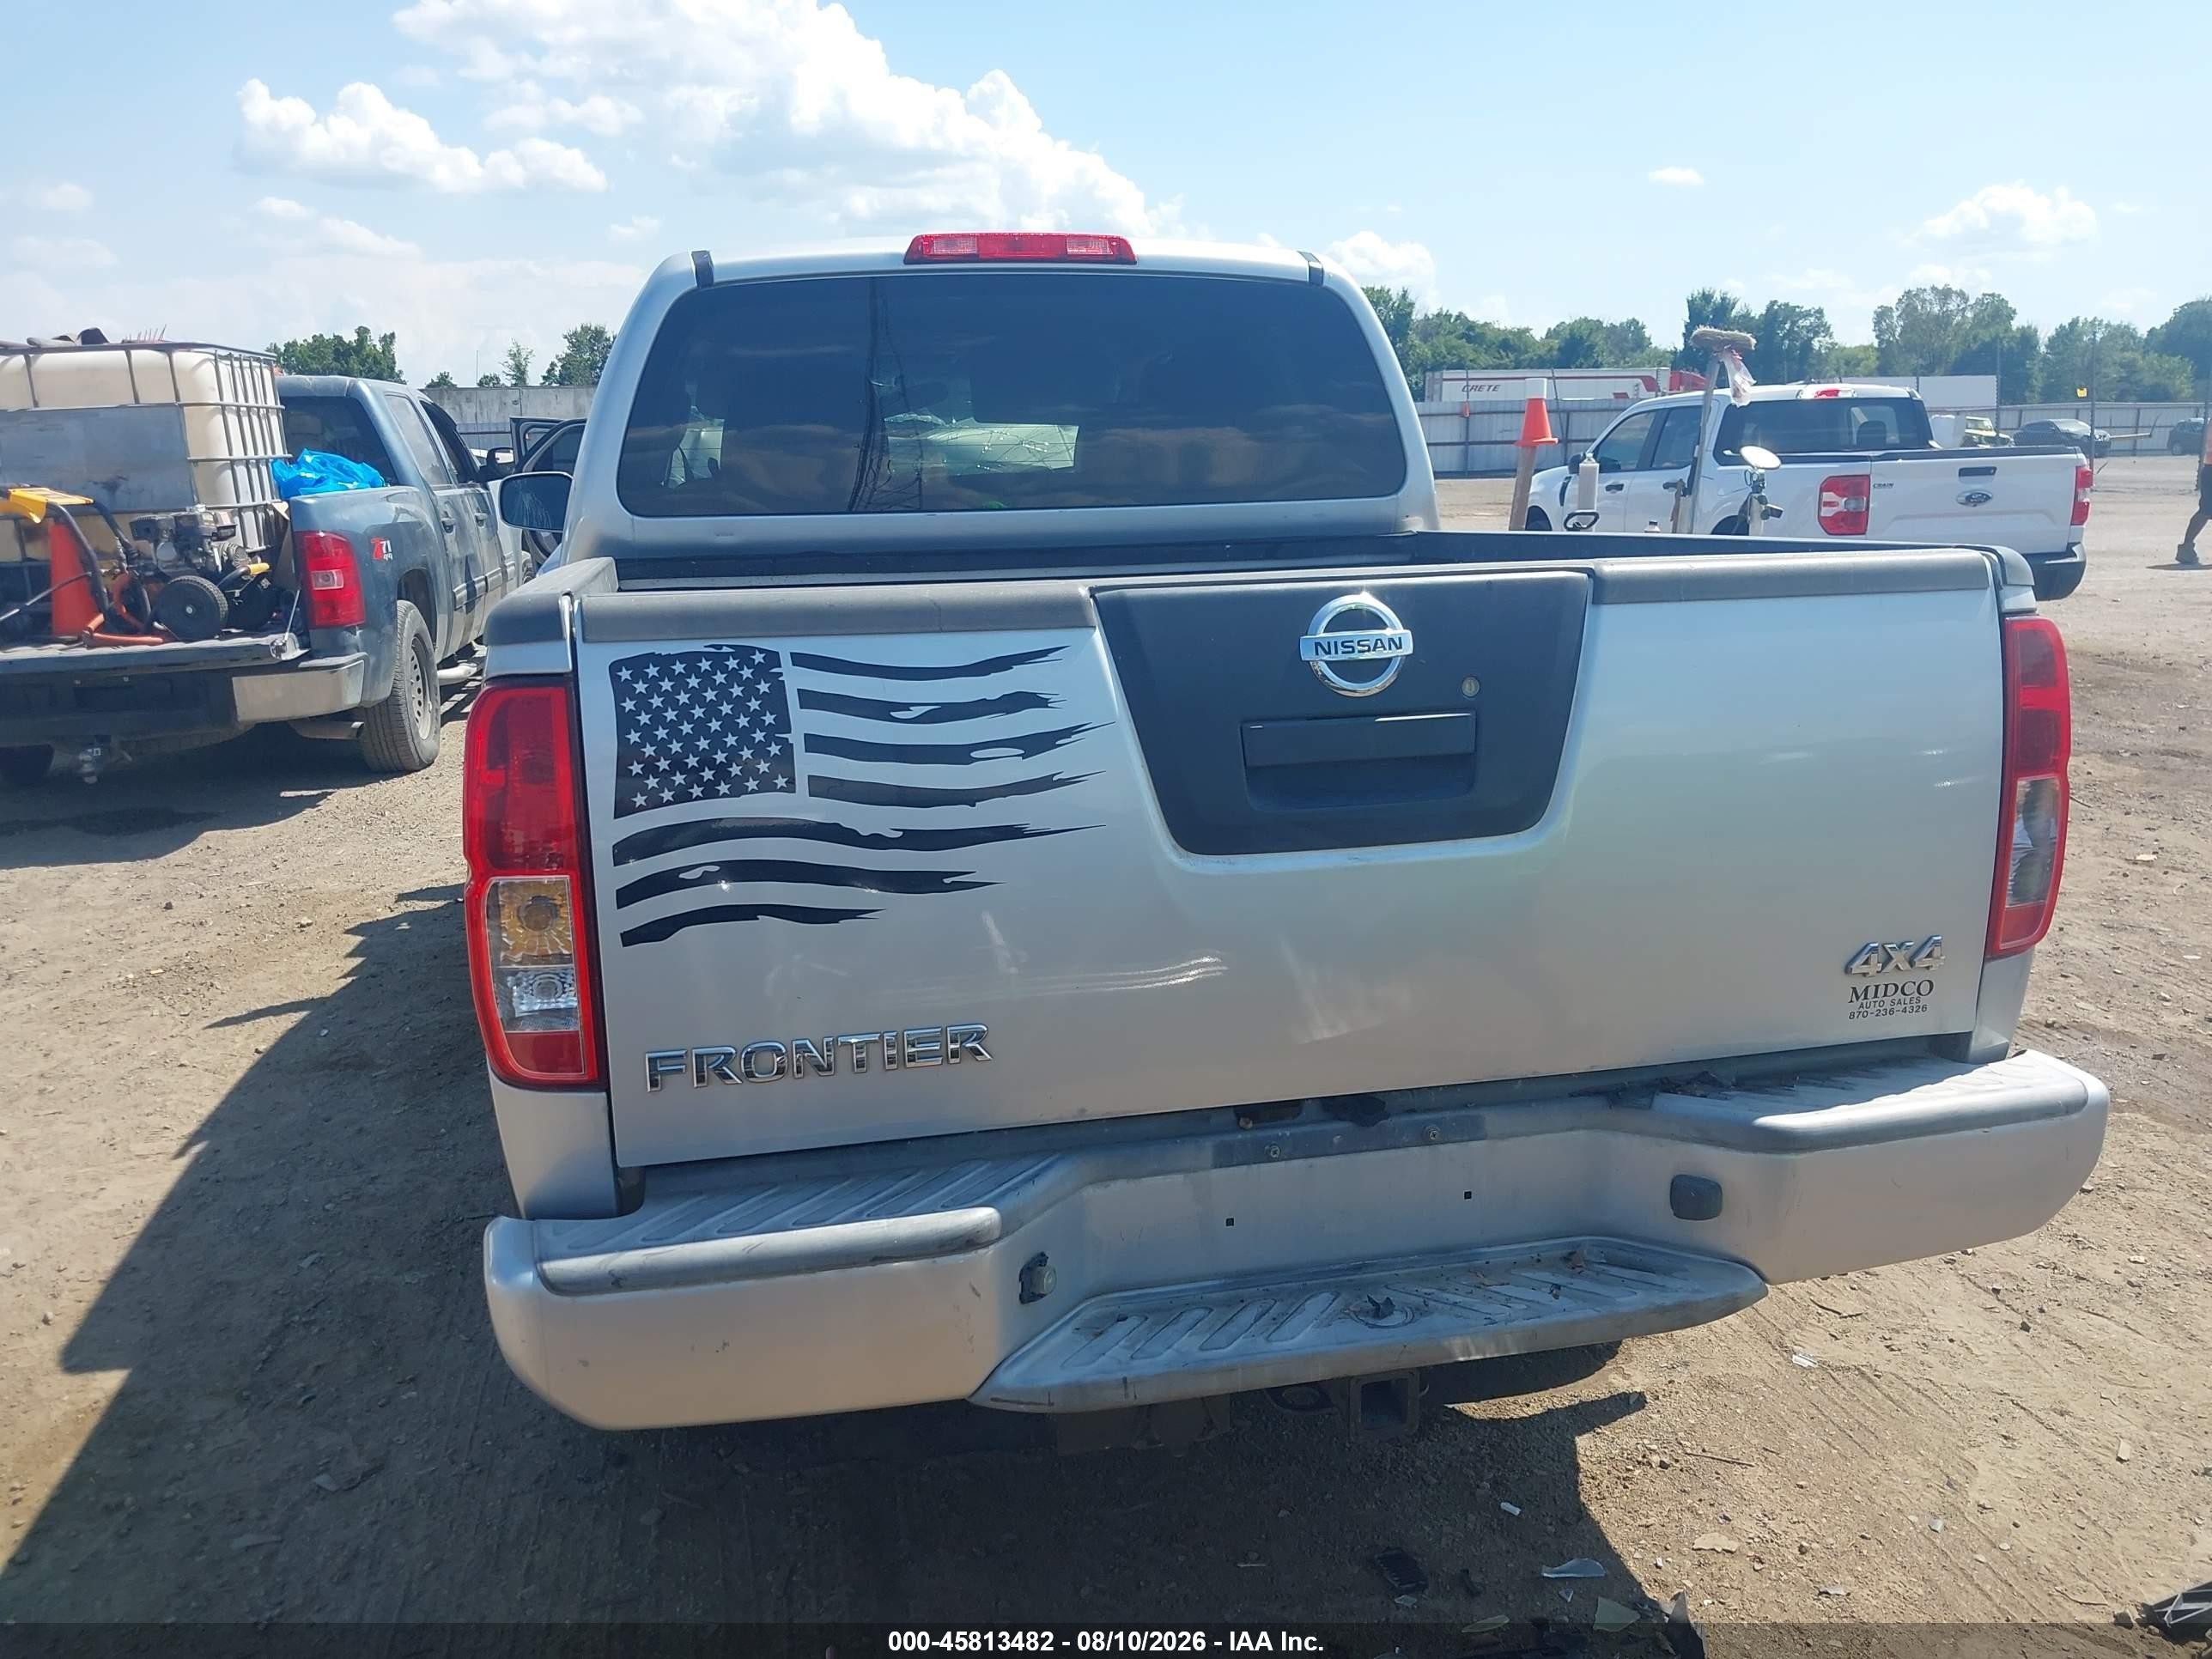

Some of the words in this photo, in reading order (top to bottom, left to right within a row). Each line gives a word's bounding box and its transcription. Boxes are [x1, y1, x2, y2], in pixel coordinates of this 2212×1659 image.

[1315, 637, 1402, 656] NISSAN
[1849, 979, 1934, 1003] MIDCO
[1849, 1004, 1928, 1019] 870-236-4326
[1858, 1000, 1886, 1010] AUTO
[1891, 996, 1922, 1007] SALES
[645, 1023, 993, 1092] FRONTIER
